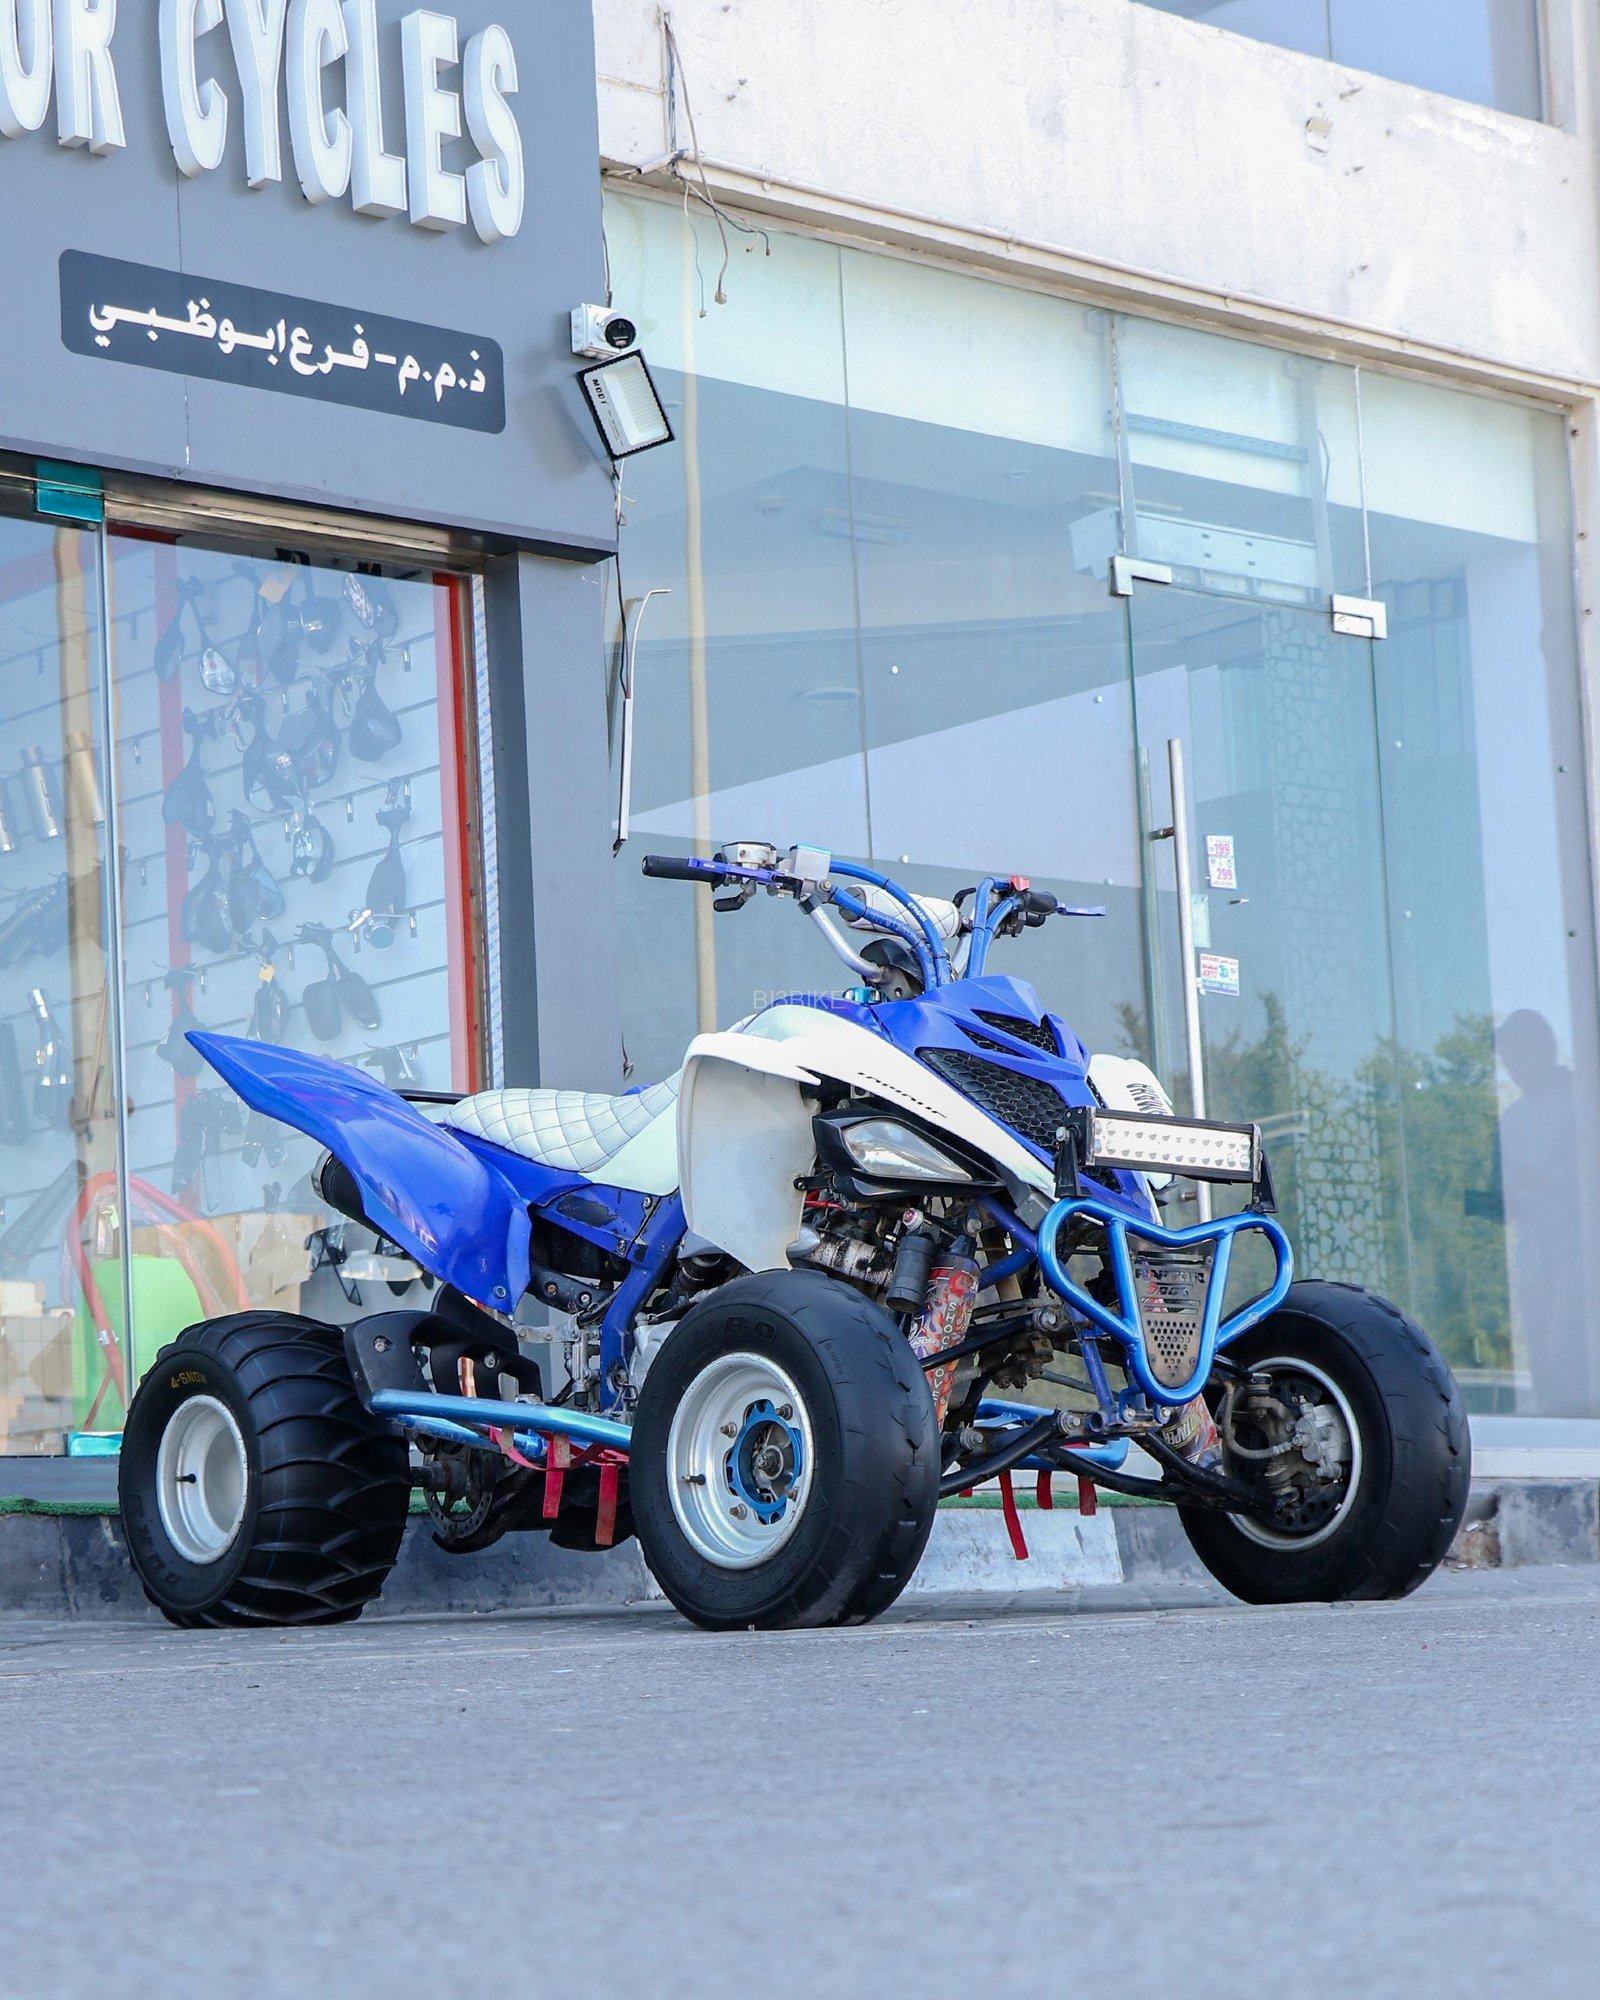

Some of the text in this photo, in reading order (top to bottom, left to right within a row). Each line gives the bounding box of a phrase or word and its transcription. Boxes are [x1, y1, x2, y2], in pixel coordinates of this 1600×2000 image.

[158, 0, 525, 245] CYCLES
[1214, 843, 1231, 855] 199
[1217, 868, 1233, 880] 299
